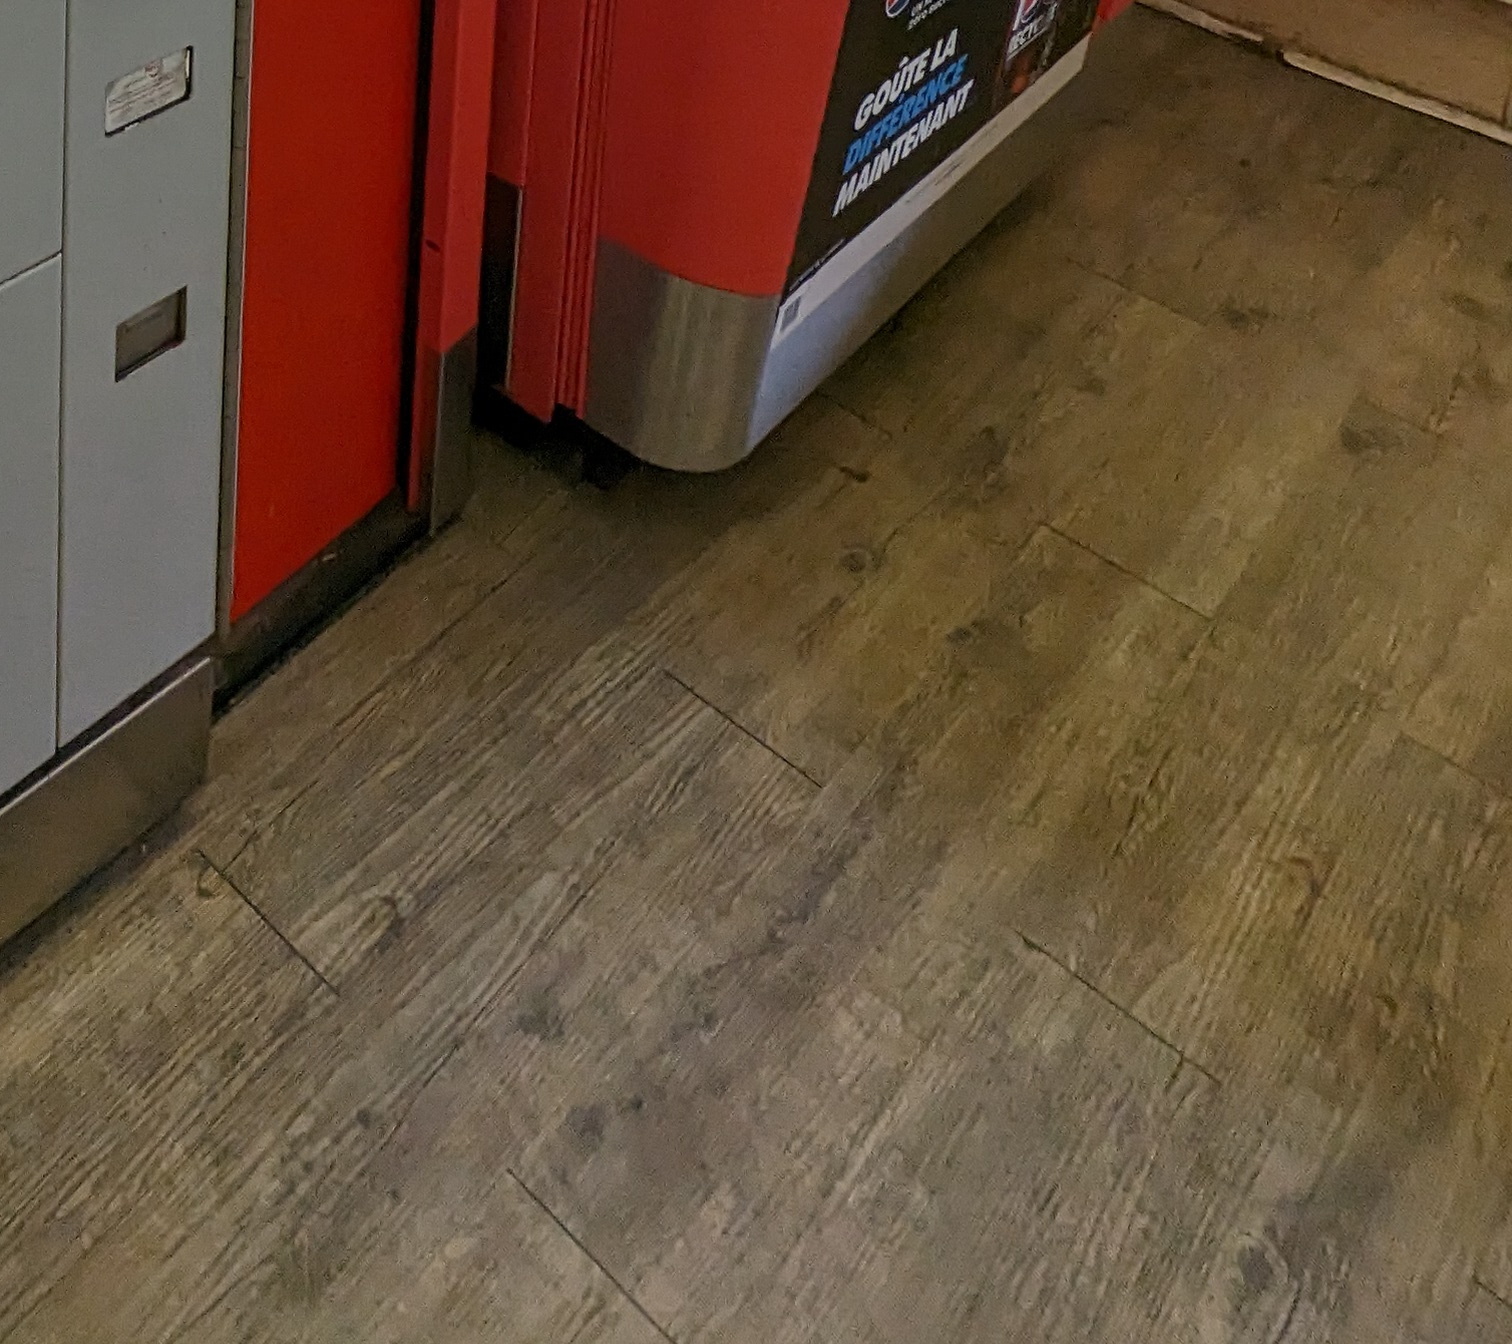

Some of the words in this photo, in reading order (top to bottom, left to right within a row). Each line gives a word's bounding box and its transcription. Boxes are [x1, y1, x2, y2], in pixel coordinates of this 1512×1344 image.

[843, 53, 969, 175] DIFFÉRENCE
[854, 47, 931, 131] GOÛTE
[930, 28, 958, 72] LA
[832, 78, 974, 217] MAINTENANT
